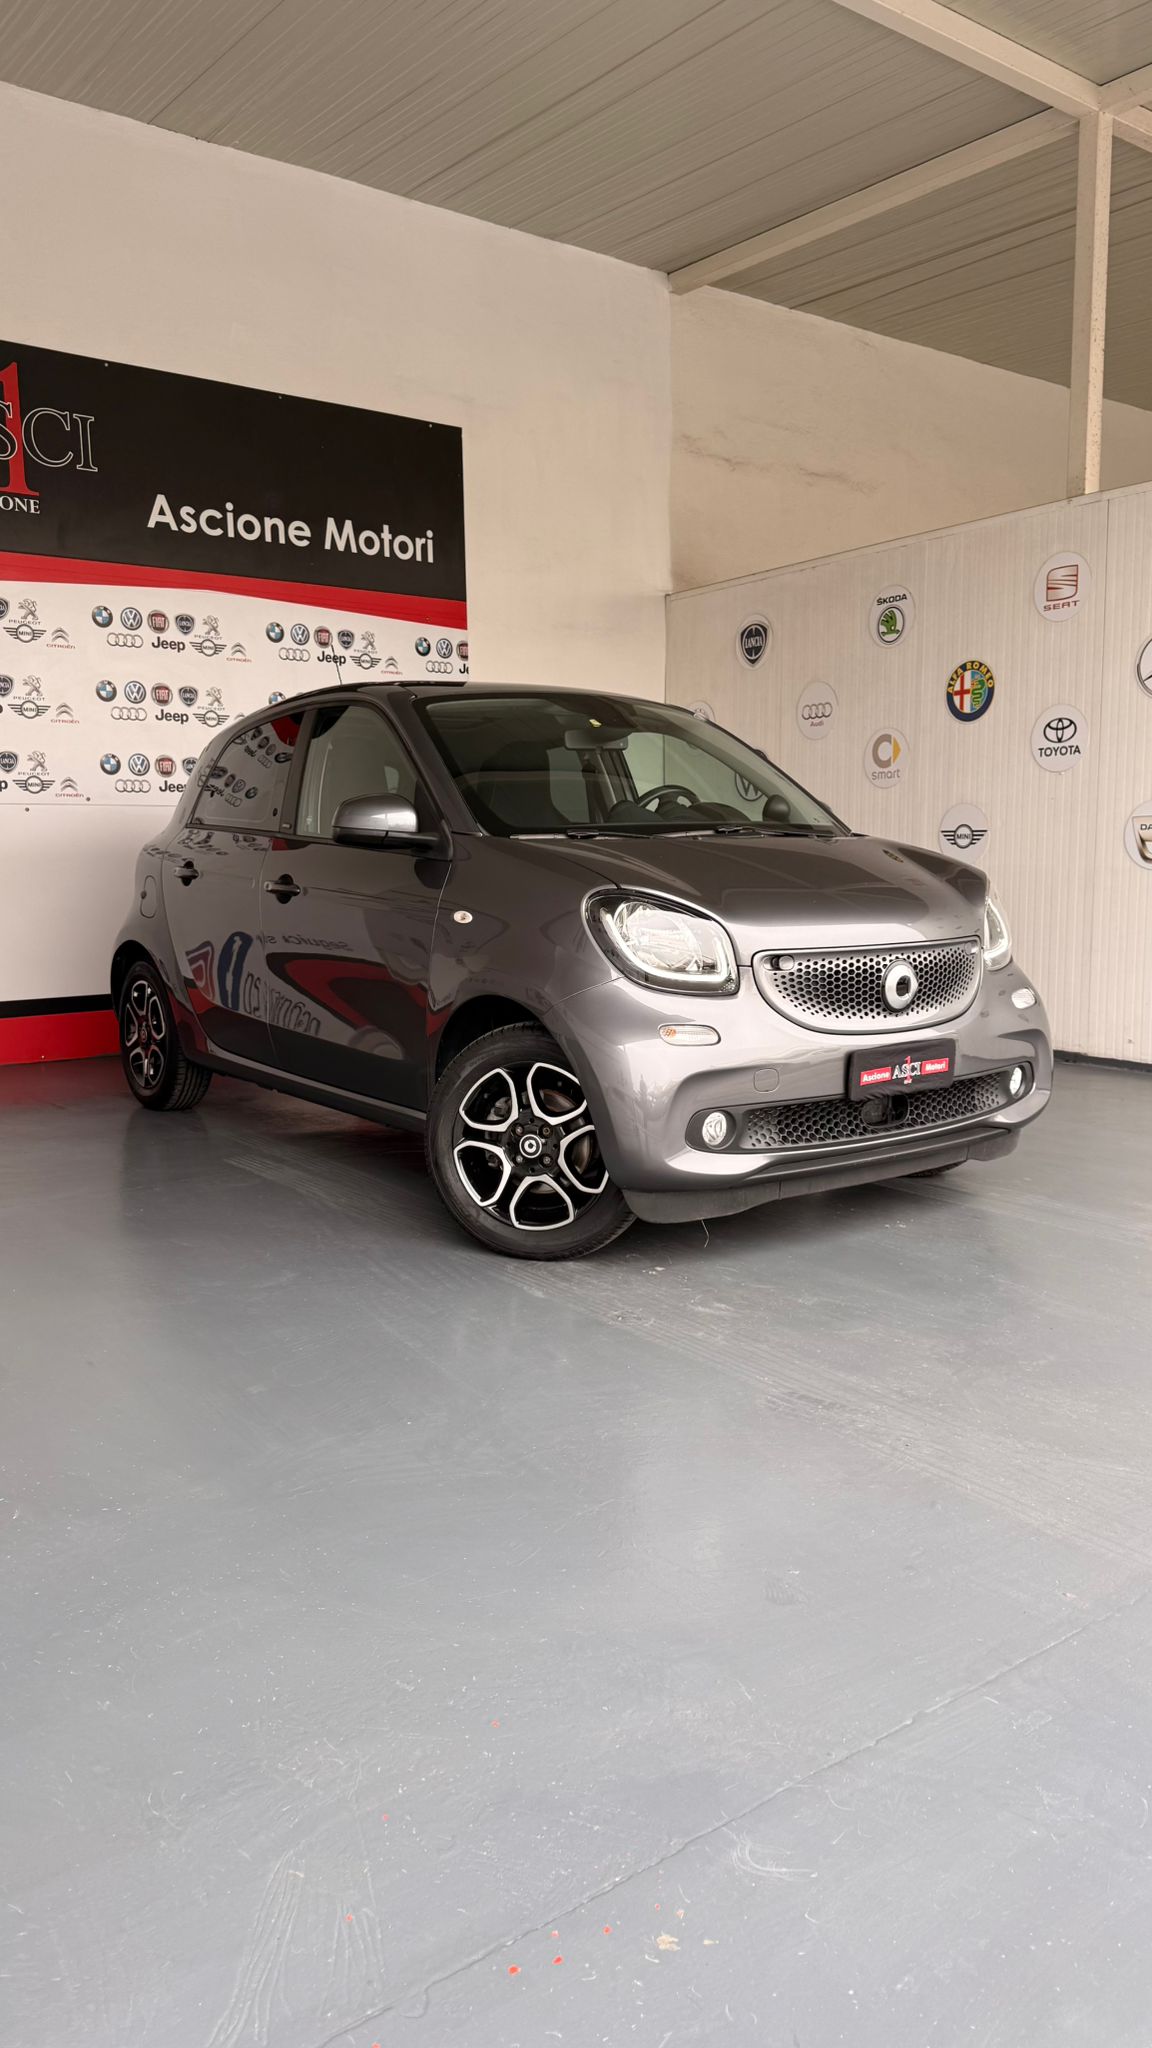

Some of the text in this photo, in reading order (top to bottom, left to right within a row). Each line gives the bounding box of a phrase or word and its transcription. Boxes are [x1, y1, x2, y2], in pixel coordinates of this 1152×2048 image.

[147, 493, 434, 563] Ascione Motori
[1043, 600, 1080, 612] SEAT
[151, 636, 185, 653] Jeep
[745, 636, 763, 648] LANCIA
[317, 651, 346, 666] Jeep
[947, 661, 994, 694] ALFA ROMEO
[155, 709, 189, 725] Jeep
[1038, 745, 1081, 757] TOYOTA
[872, 769, 900, 780] smart
[159, 780, 187, 793] Jee
[862, 1071, 890, 1083] Ascione
[925, 1061, 946, 1072] Motori
